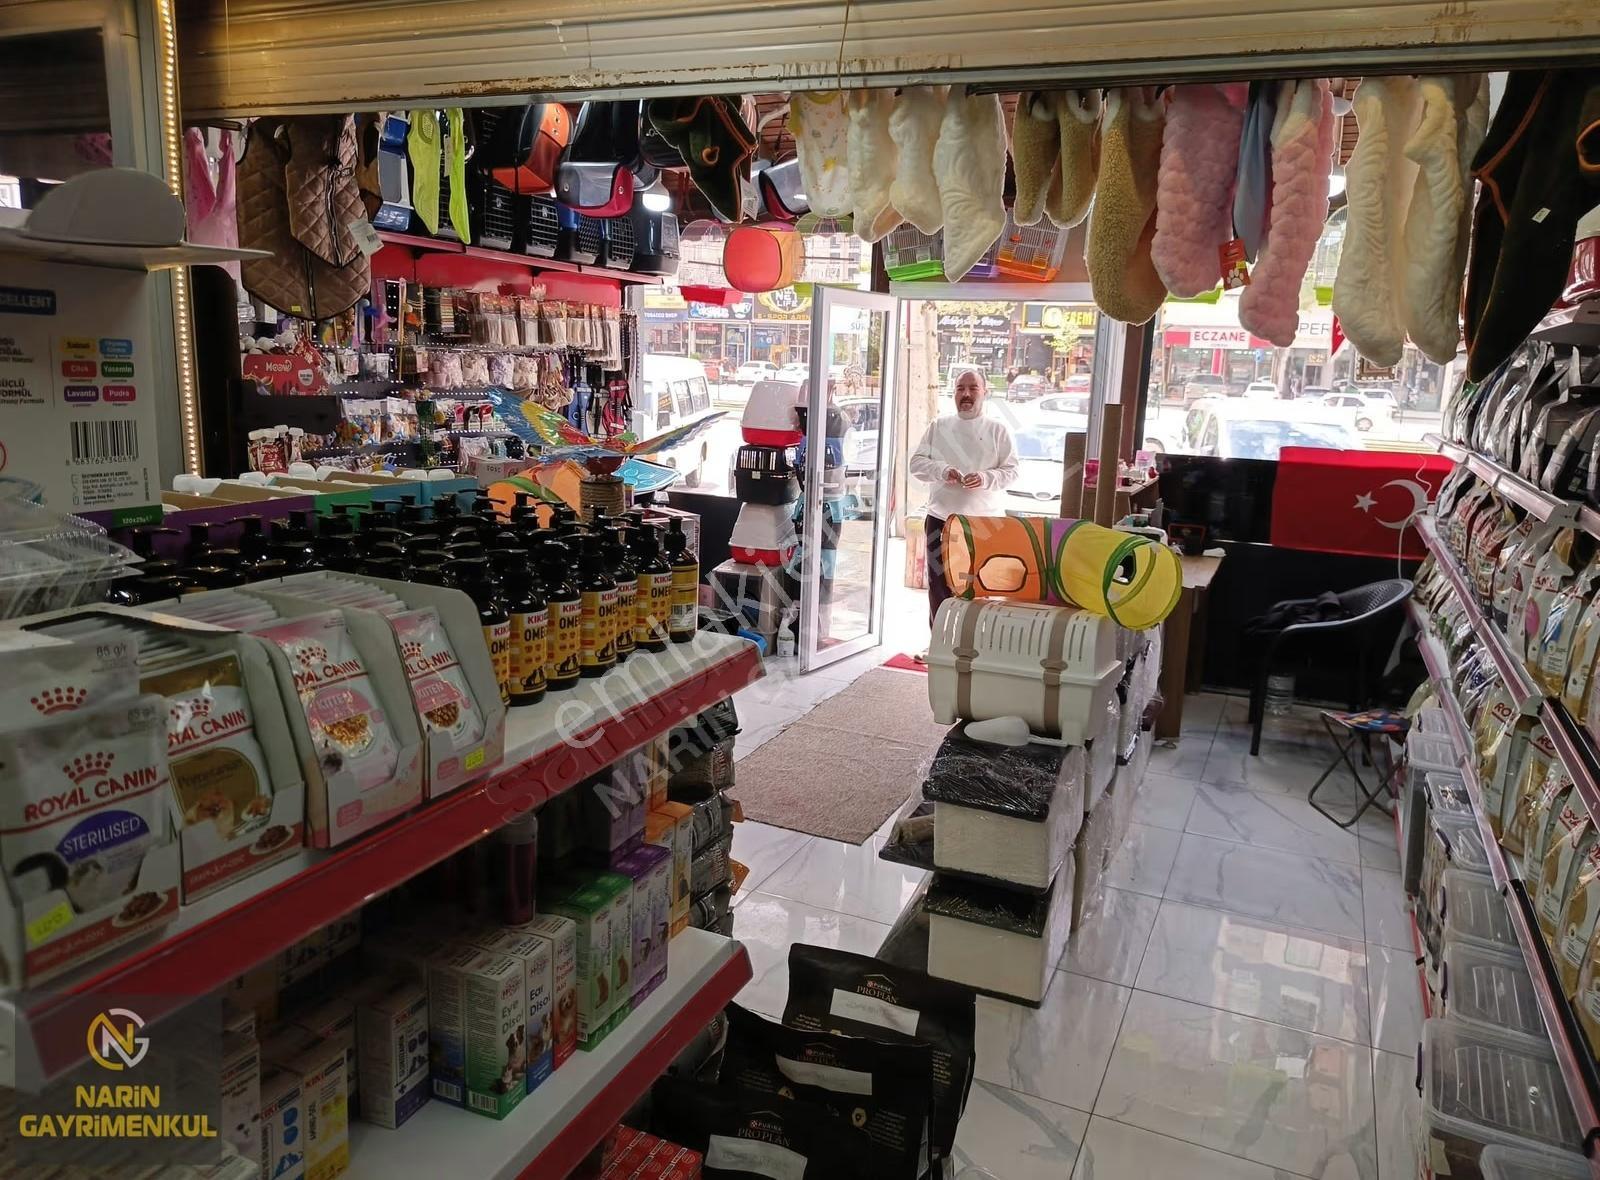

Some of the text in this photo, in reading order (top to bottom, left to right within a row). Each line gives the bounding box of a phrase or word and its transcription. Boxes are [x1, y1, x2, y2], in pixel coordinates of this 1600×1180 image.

[1193, 331, 1246, 342] ECZANE
[1299, 323, 1329, 336] PER
[654, 575, 669, 584] KIKI
[527, 613, 544, 625] KIKI
[293, 669, 323, 688] OYAL
[168, 708, 248, 748] OYAL CANIN
[24, 765, 158, 823] ROYAL CANIN
[62, 816, 141, 855] STERILISED
[529, 985, 544, 1000] Ear
[857, 985, 898, 1004] PRO PLAN
[738, 1127, 792, 1147] PRO PLAN
